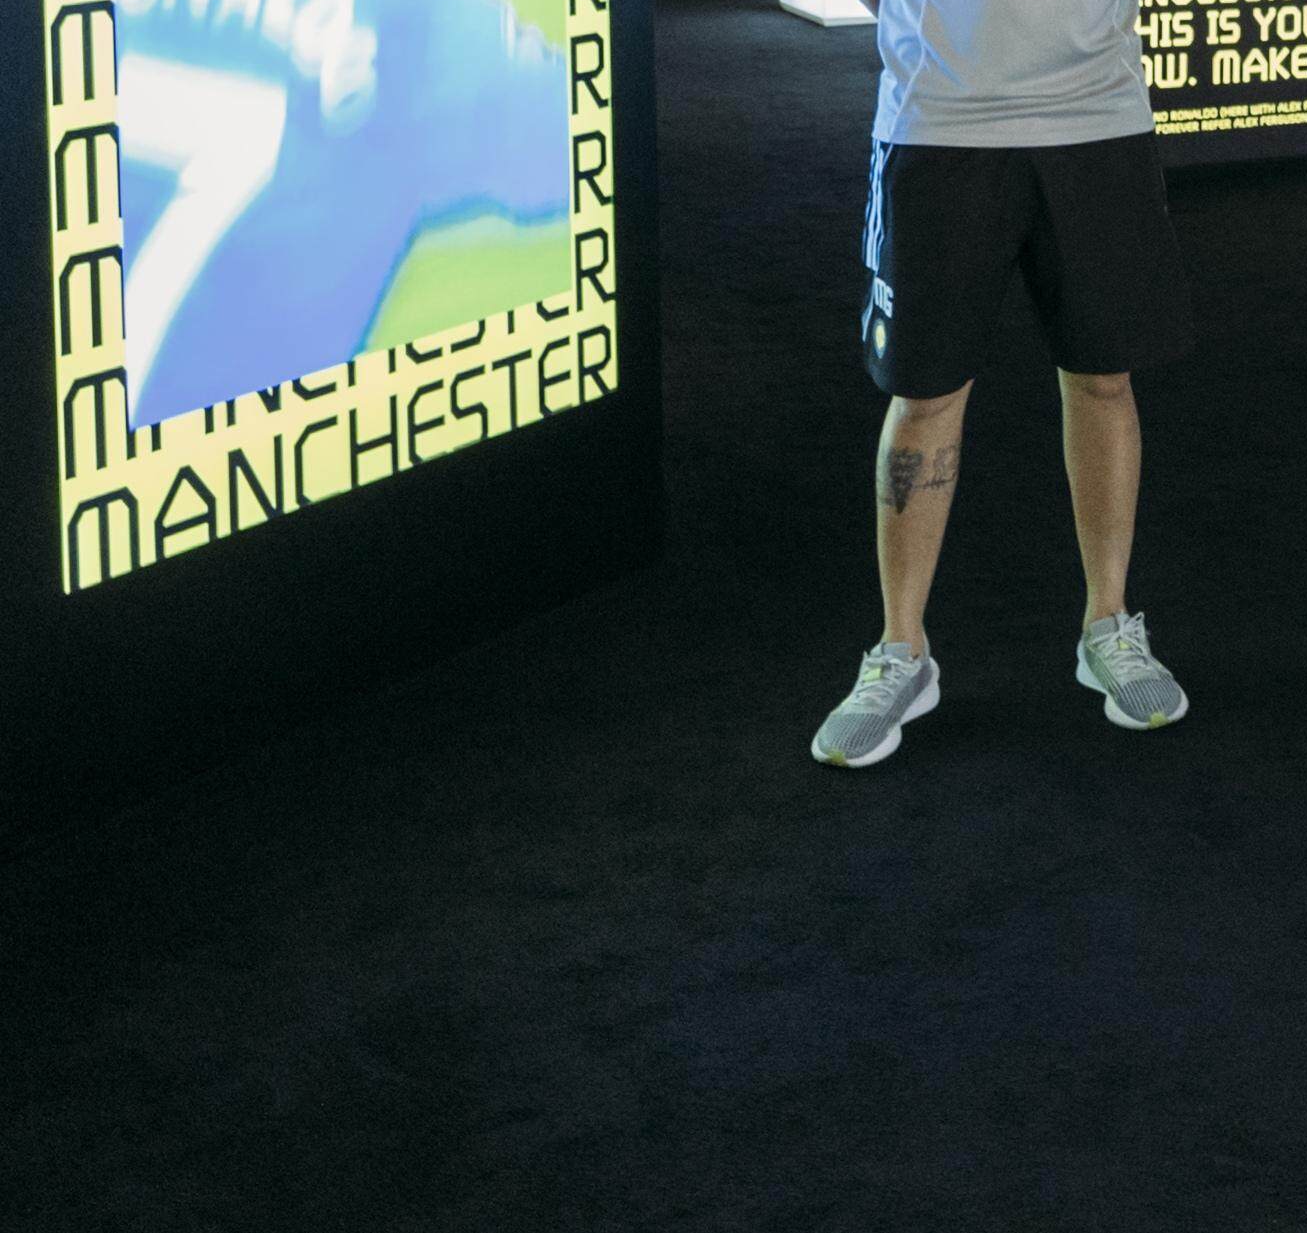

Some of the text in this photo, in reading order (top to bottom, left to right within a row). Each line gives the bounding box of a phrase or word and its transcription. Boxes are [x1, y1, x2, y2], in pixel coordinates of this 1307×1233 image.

[1206, 8, 1242, 46] IS
[1233, 117, 1259, 129] ALEX
[1250, 103, 1276, 116] WITH
[1277, 101, 1302, 113] ALEX
[874, 275, 894, 319] MG
[67, 325, 618, 590] MANCHESTER
